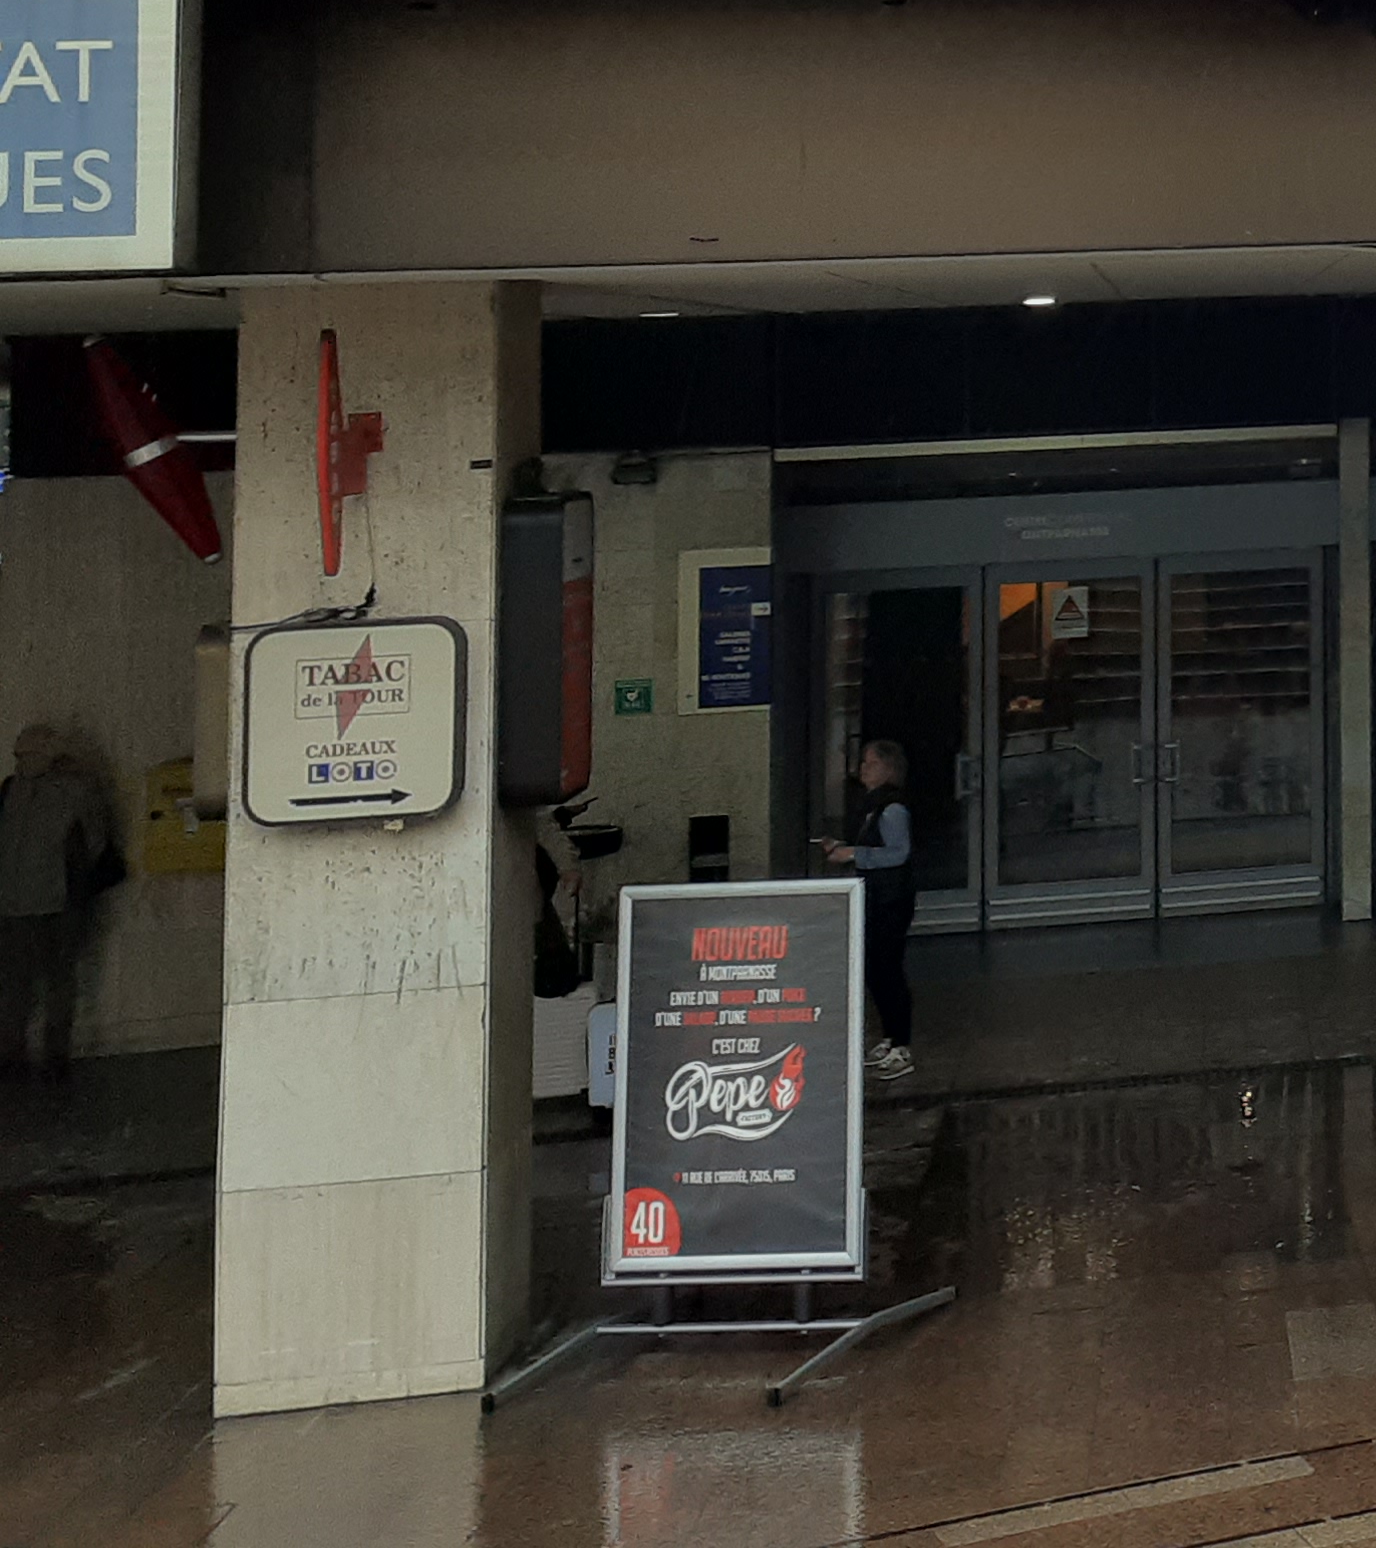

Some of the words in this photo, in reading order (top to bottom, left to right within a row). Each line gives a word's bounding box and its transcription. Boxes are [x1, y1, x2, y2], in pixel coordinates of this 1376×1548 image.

[301, 660, 405, 687] TABAC
[300, 693, 322, 708] de
[350, 688, 405, 705] TOUR
[305, 740, 396, 759] CADEAUX
[307, 758, 397, 784] LOTO
[691, 925, 789, 962] NOUVEAU
[708, 964, 777, 981] MONTPARNASSE
[670, 991, 696, 1006] ENVIE
[738, 1037, 760, 1054] CHEZ
[665, 1061, 769, 1141] Pepe
[630, 1201, 665, 1244] 40
